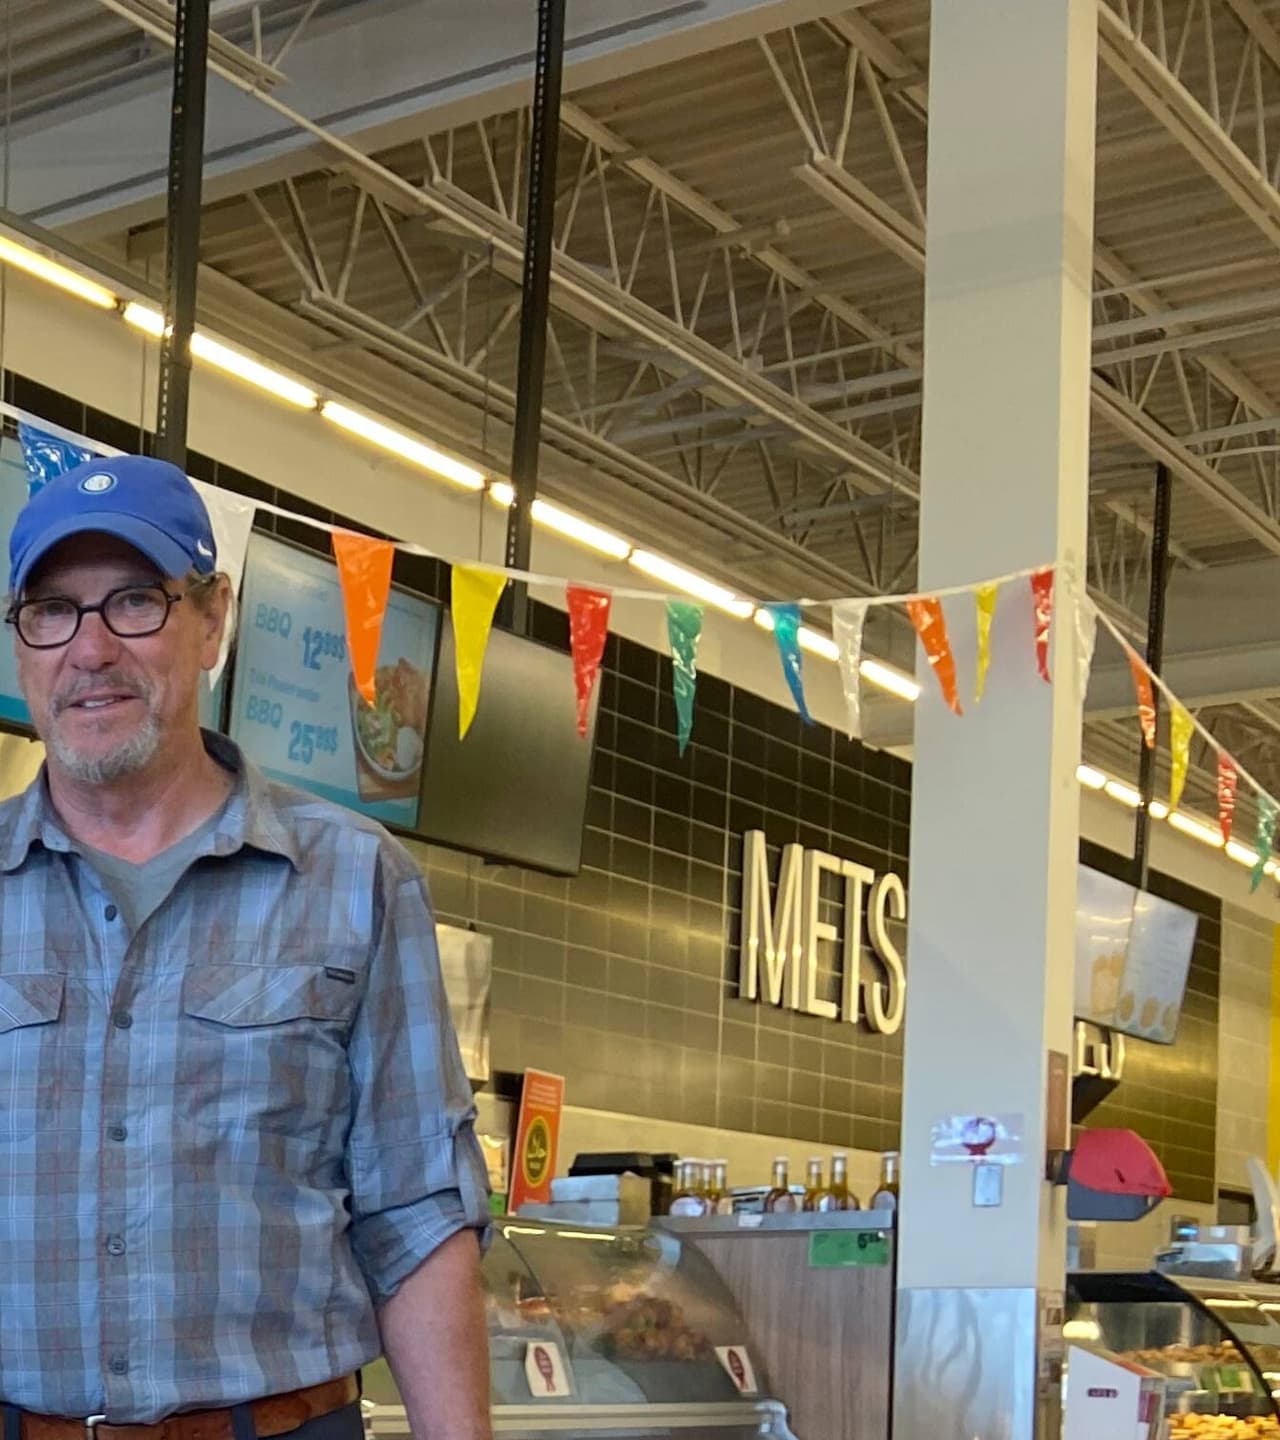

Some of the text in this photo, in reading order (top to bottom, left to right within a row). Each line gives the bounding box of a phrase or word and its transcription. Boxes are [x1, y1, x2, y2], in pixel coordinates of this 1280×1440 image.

[255, 603, 292, 640] BBQ
[245, 694, 283, 730] BBQ
[739, 829, 906, 1035] METS
